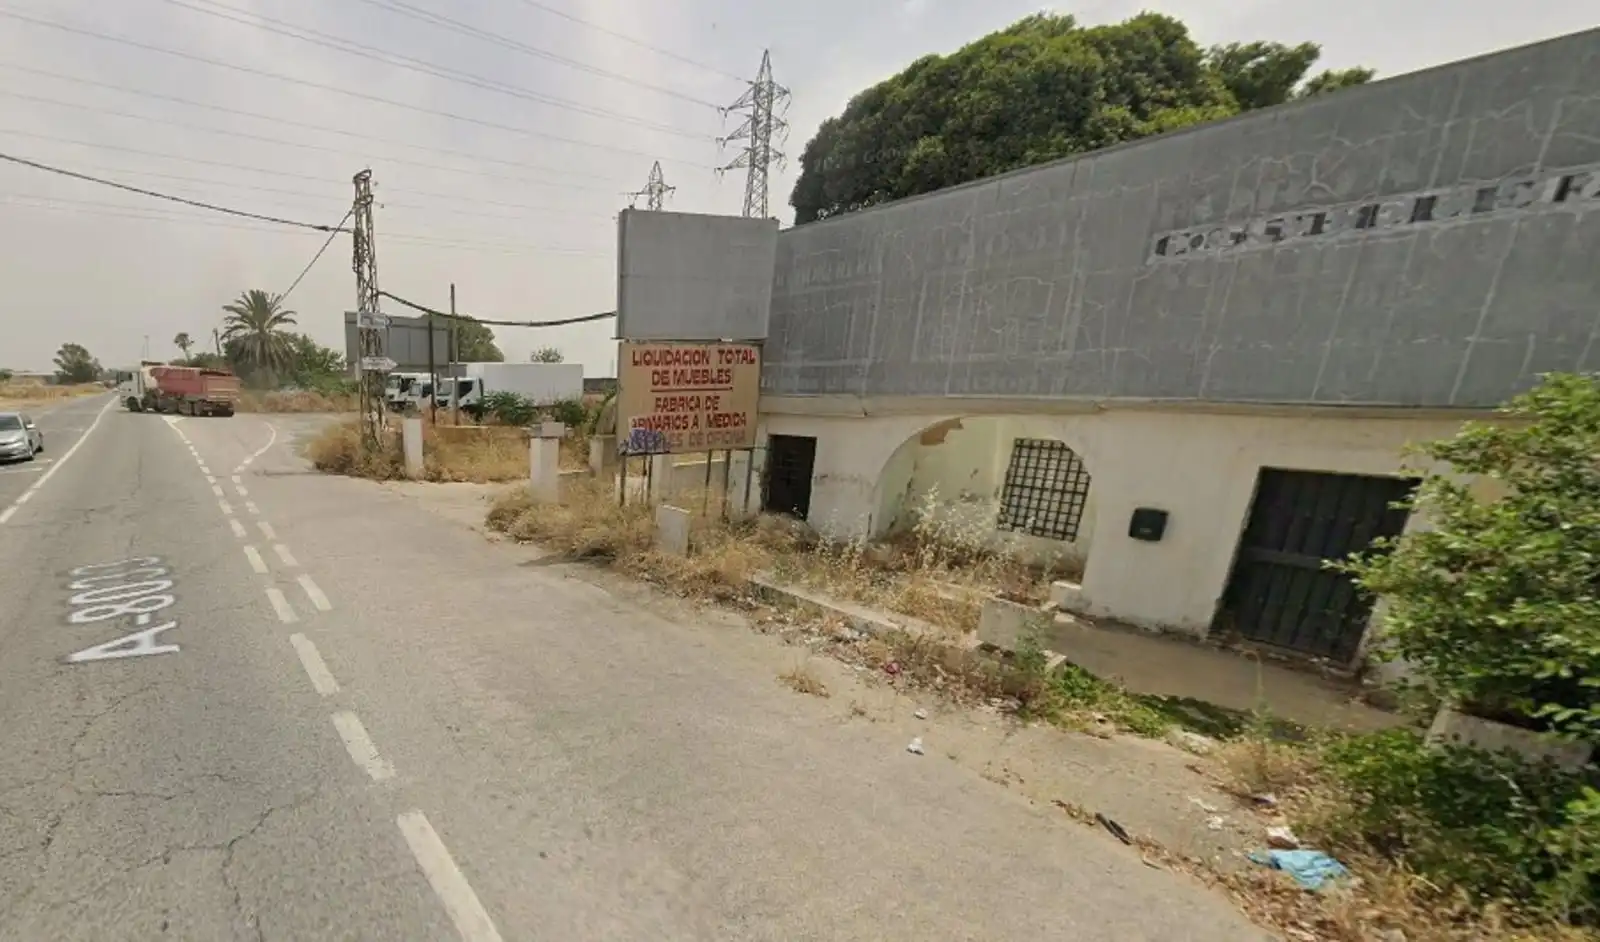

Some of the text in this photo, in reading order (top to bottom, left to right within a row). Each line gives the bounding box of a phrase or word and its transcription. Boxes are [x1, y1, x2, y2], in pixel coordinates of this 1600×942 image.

[632, 348, 756, 366] LIQUIDACION TOTAL
[652, 368, 732, 386] DE MUEBLES
[655, 395, 720, 412] FABRICA DE
[691, 414, 699, 430] A
[706, 411, 746, 429] MEDIDA
